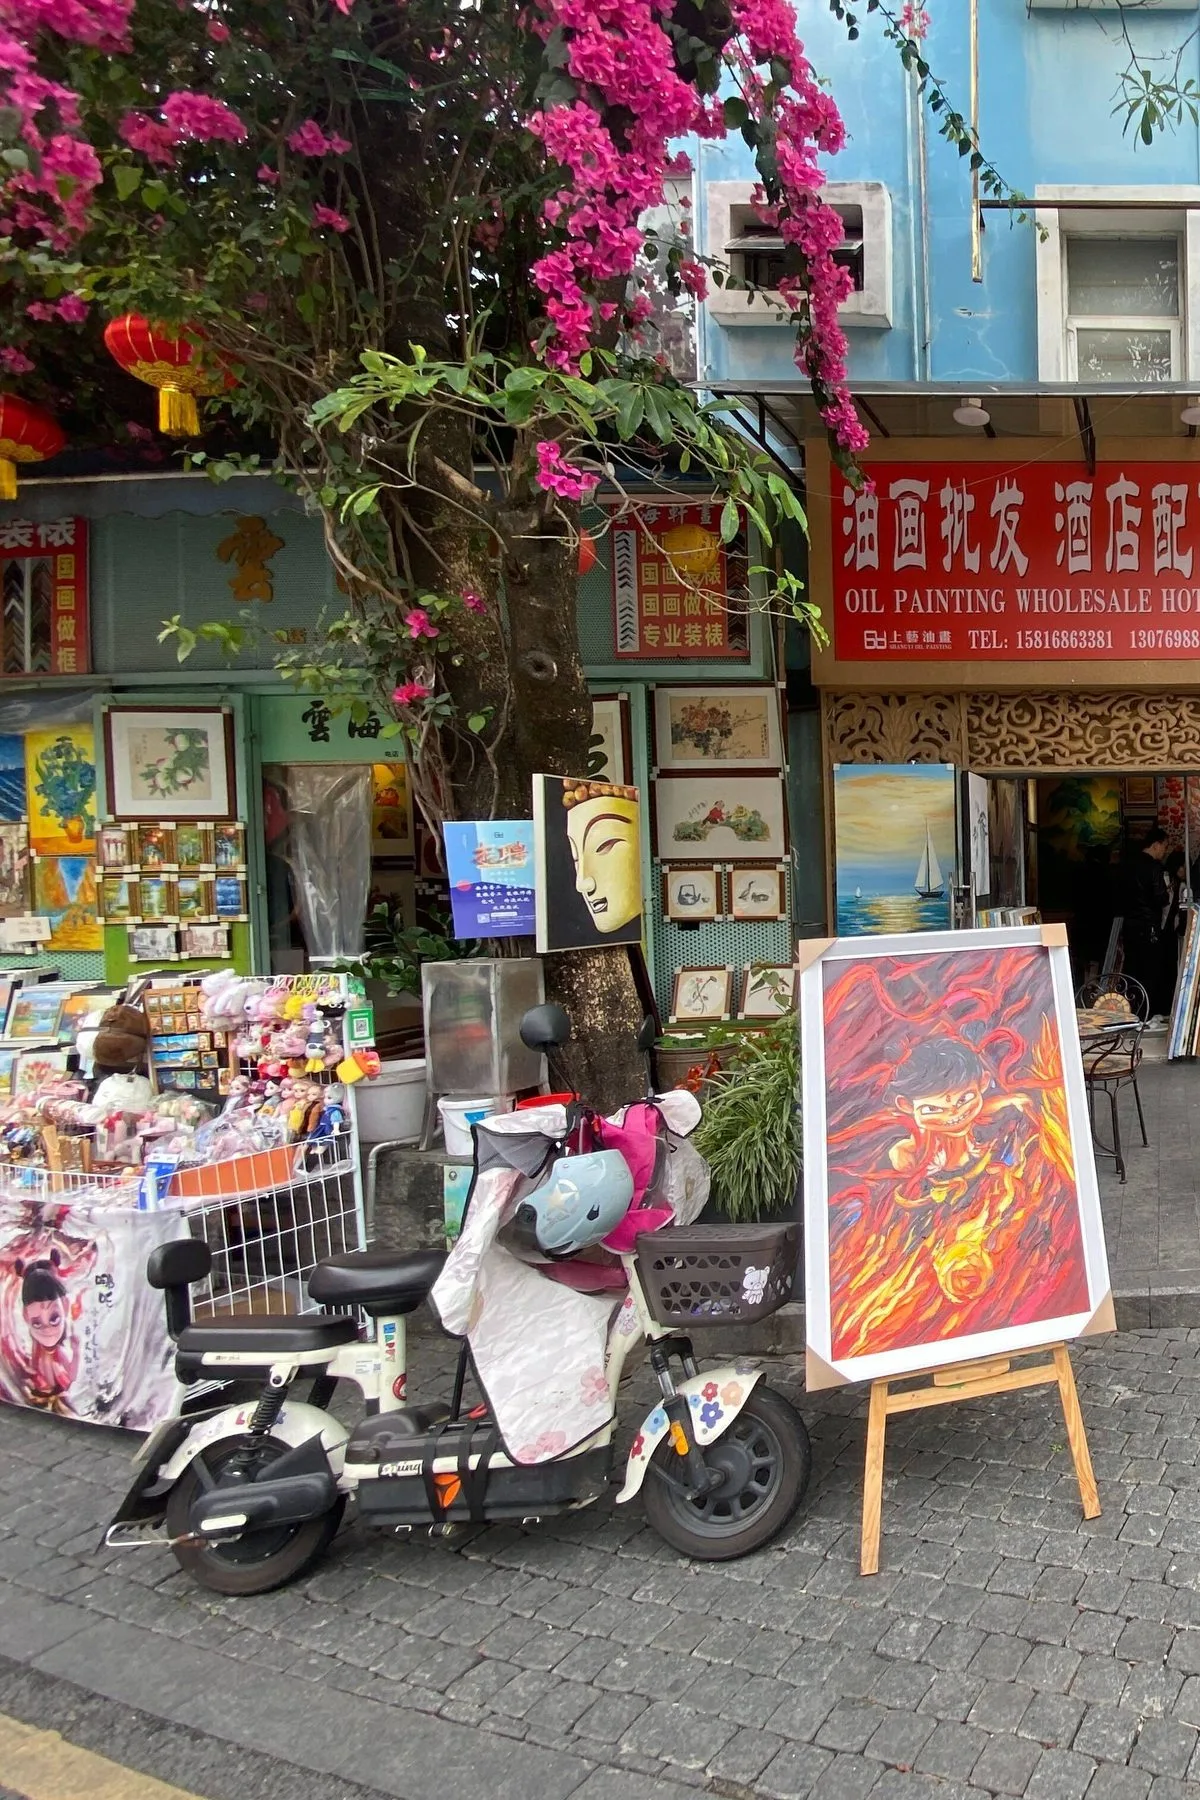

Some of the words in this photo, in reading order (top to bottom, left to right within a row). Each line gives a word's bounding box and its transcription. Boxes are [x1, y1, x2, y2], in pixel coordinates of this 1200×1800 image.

[842, 477, 1030, 577] 油画批发
[56, 554, 76, 673] 国画做框
[642, 593, 723, 616] 国画做框
[845, 588, 885, 614] OIL
[893, 588, 1006, 614] PAINTING
[1016, 588, 1153, 614] WHOLESALE
[643, 623, 724, 647] 专业装裱
[968, 630, 1009, 649] TEL:
[1016, 630, 1114, 649] 15816863381
